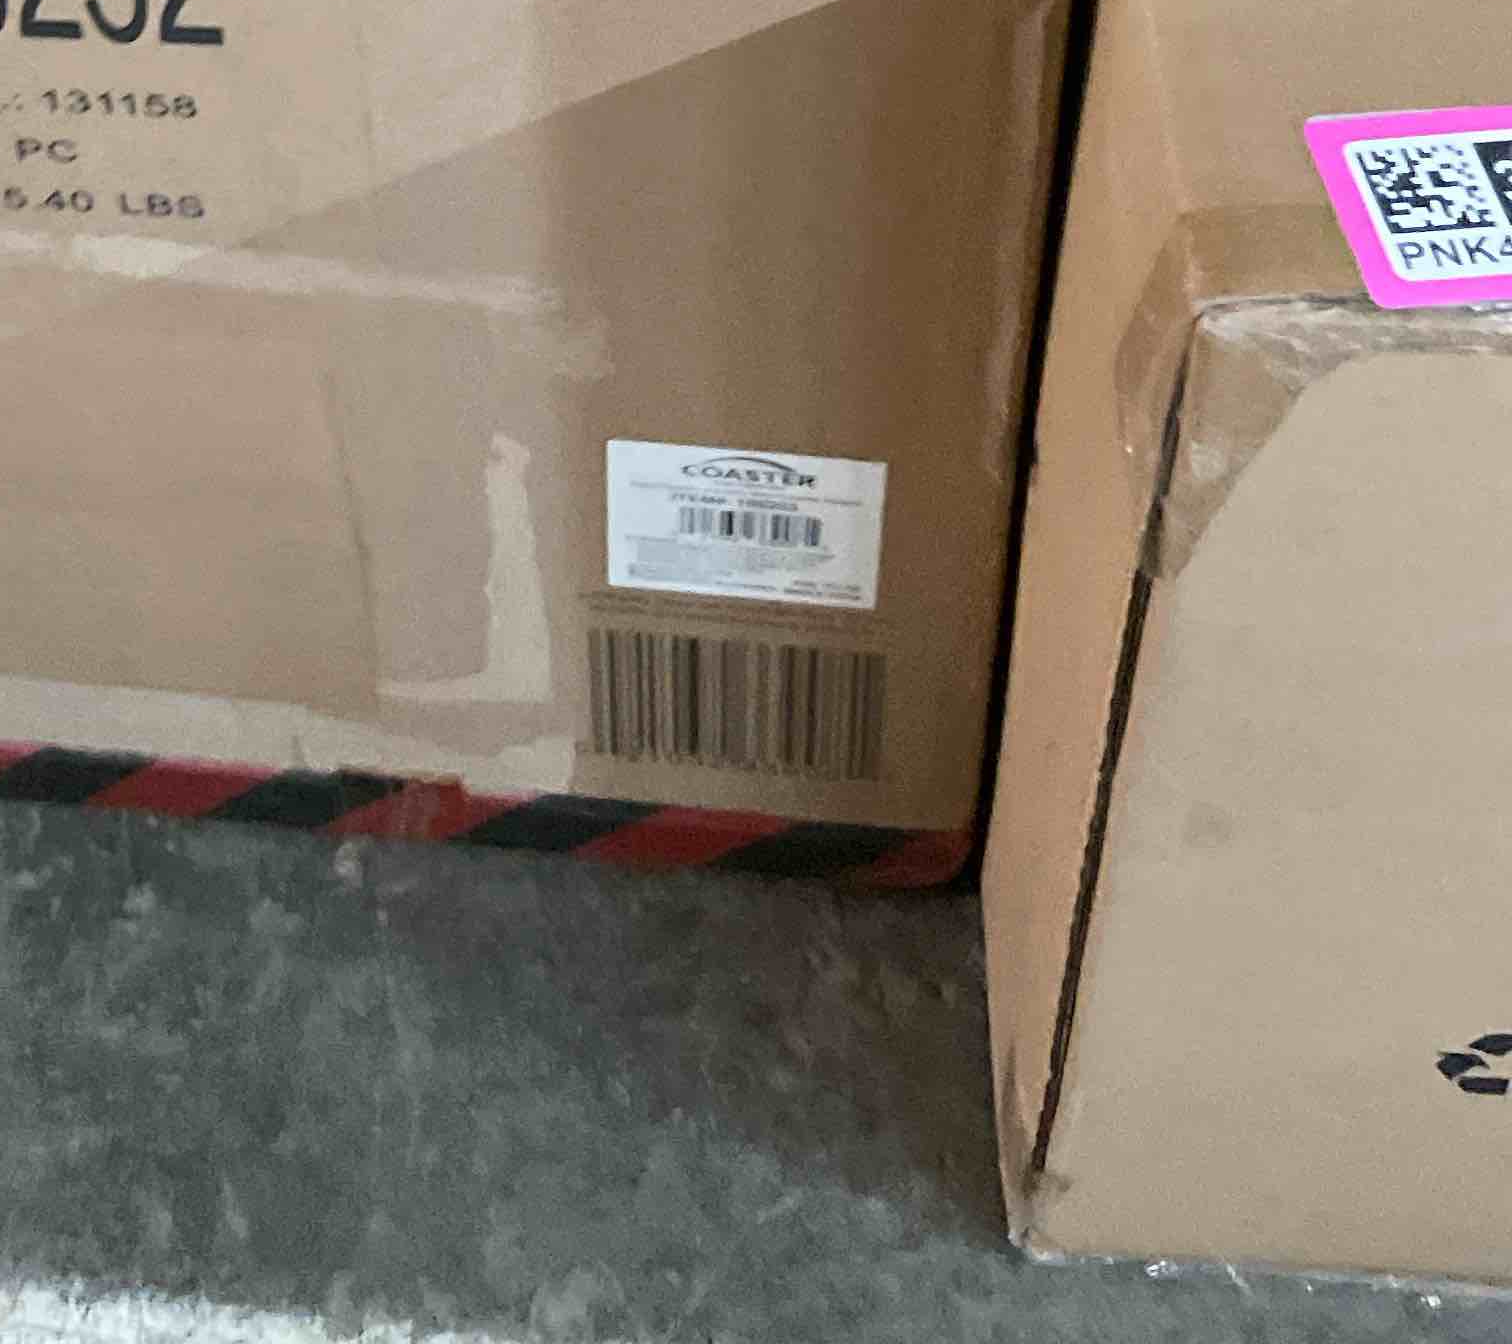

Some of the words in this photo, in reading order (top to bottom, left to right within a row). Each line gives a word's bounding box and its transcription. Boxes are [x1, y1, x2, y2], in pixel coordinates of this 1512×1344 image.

[40, 88, 199, 120] 131158
[15, 136, 79, 164] PC
[118, 191, 206, 219] LBS
[681, 463, 817, 490] COASTER
